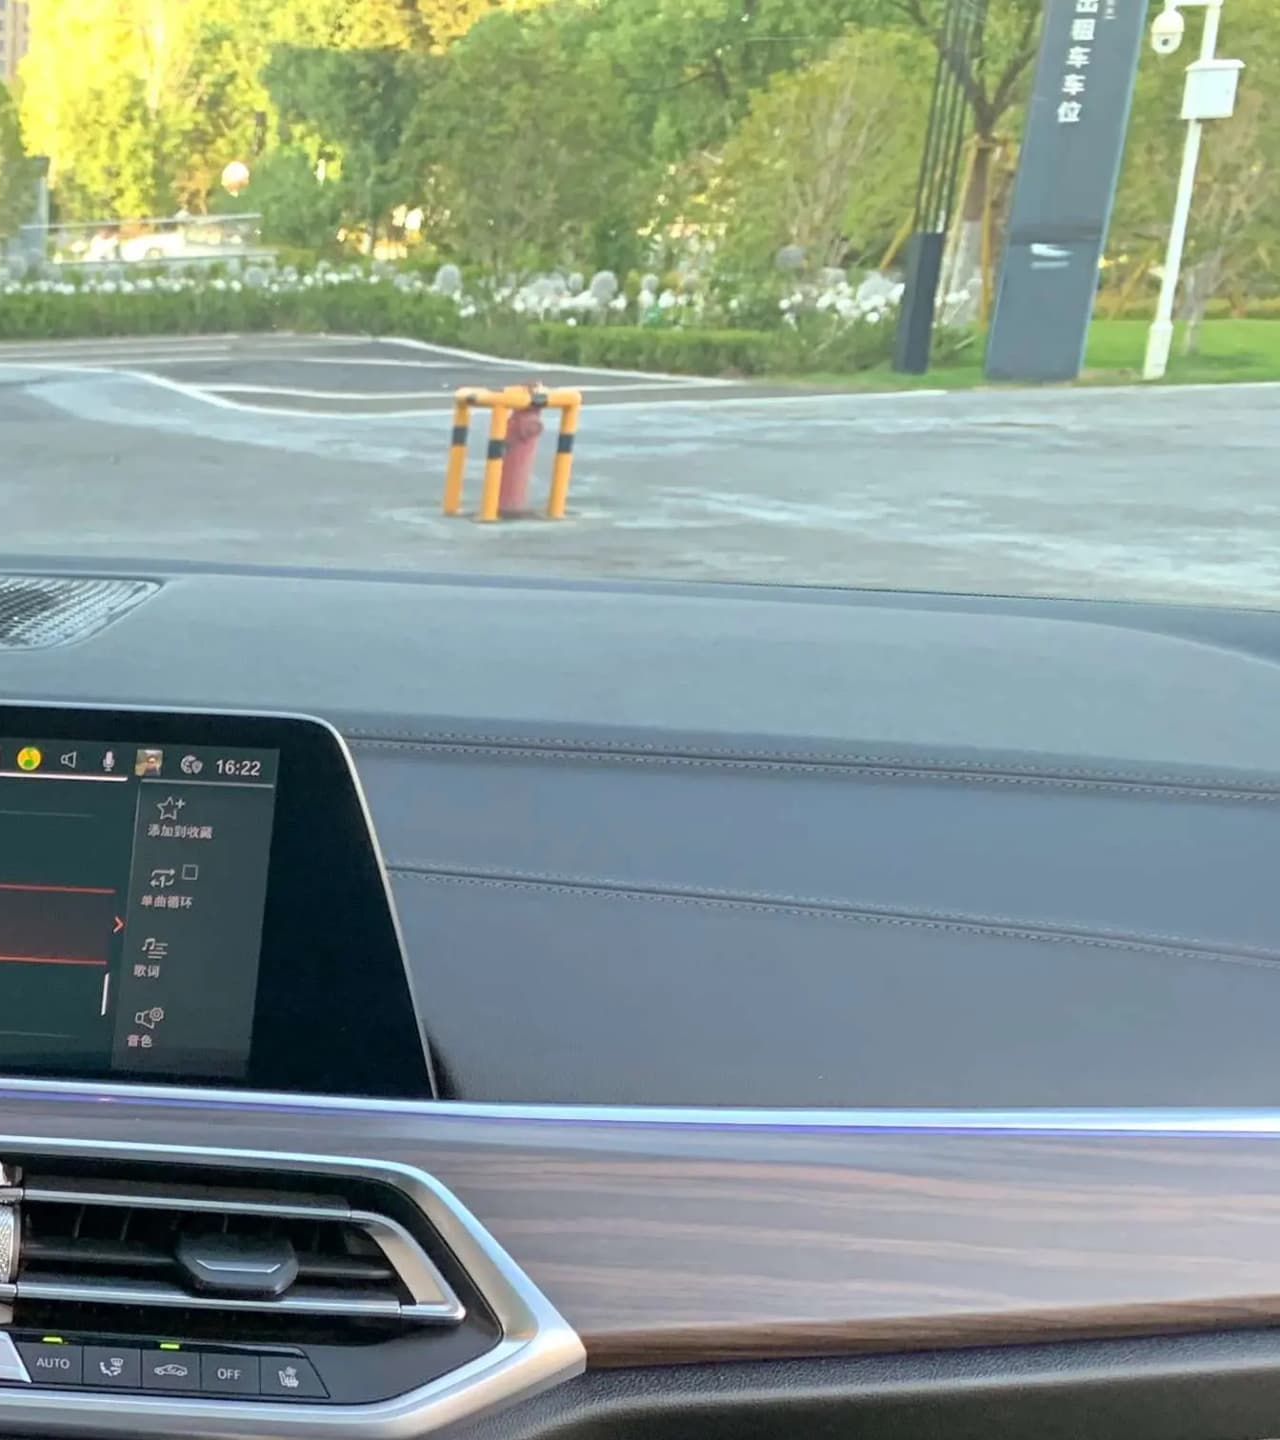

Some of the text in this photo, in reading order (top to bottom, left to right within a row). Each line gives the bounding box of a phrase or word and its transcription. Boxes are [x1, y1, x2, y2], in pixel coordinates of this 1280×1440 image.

[215, 759, 261, 776] 16:22
[147, 823, 213, 840] 添加到收藏
[133, 964, 161, 978] 歌词
[127, 1034, 153, 1048] 音色
[36, 1357, 71, 1370] AUTO
[217, 1367, 241, 1380] OFF
